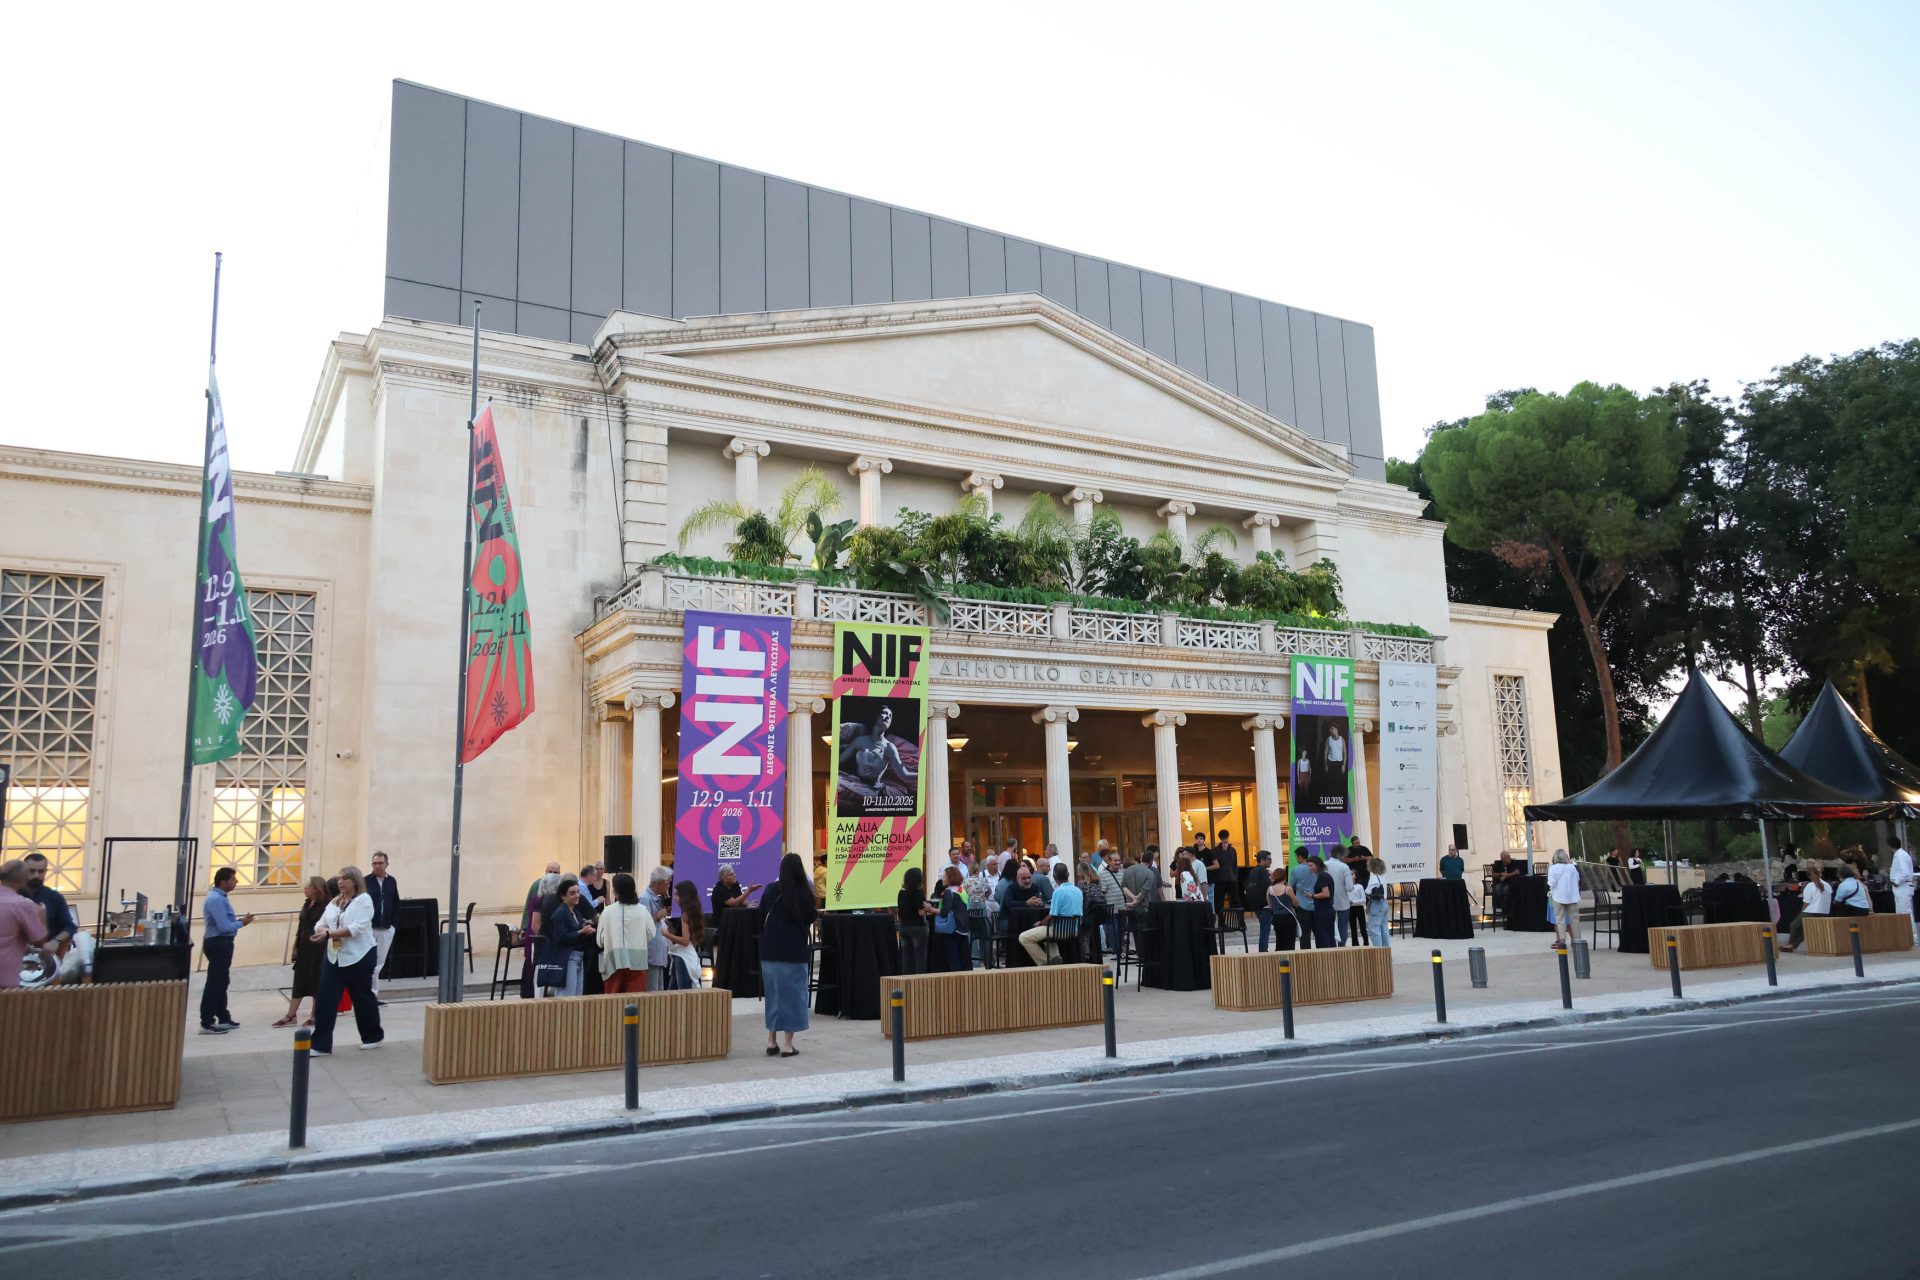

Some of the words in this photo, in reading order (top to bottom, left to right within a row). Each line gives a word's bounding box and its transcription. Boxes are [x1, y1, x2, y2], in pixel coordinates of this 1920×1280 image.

[769, 630, 780, 685] ΛΕΥΚΩΣΙΑΣ
[842, 631, 922, 678] NIF
[940, 660, 1061, 683] ΔΗΜΟΤΙΚΟ
[1079, 668, 1154, 688] ΘΕΑΤΡΟ
[1171, 673, 1271, 693] ΛΕΥΚΩΣΙΑΣ
[1296, 662, 1350, 701] NIF
[692, 625, 766, 775] NIF
[768, 687, 778, 733] ΦΕΣΤΙΒΑΛ
[766, 734, 776, 775] ΔΙΕΘΝΕΣ
[690, 790, 724, 807] 12.9
[746, 790, 773, 807] 1.11
[862, 795, 914, 806] 10-11.10.2026
[721, 807, 743, 817] 2026
[836, 821, 879, 833] AMALIA
[1294, 816, 1318, 826] ΔΑΥΙΔ
[836, 833, 913, 845] MELANCHOLIA
[1294, 827, 1301, 836] &
[1301, 826, 1332, 836] ΓΟΛΙΑΘ
[1391, 862, 1425, 870] WWW.NIF.CY
